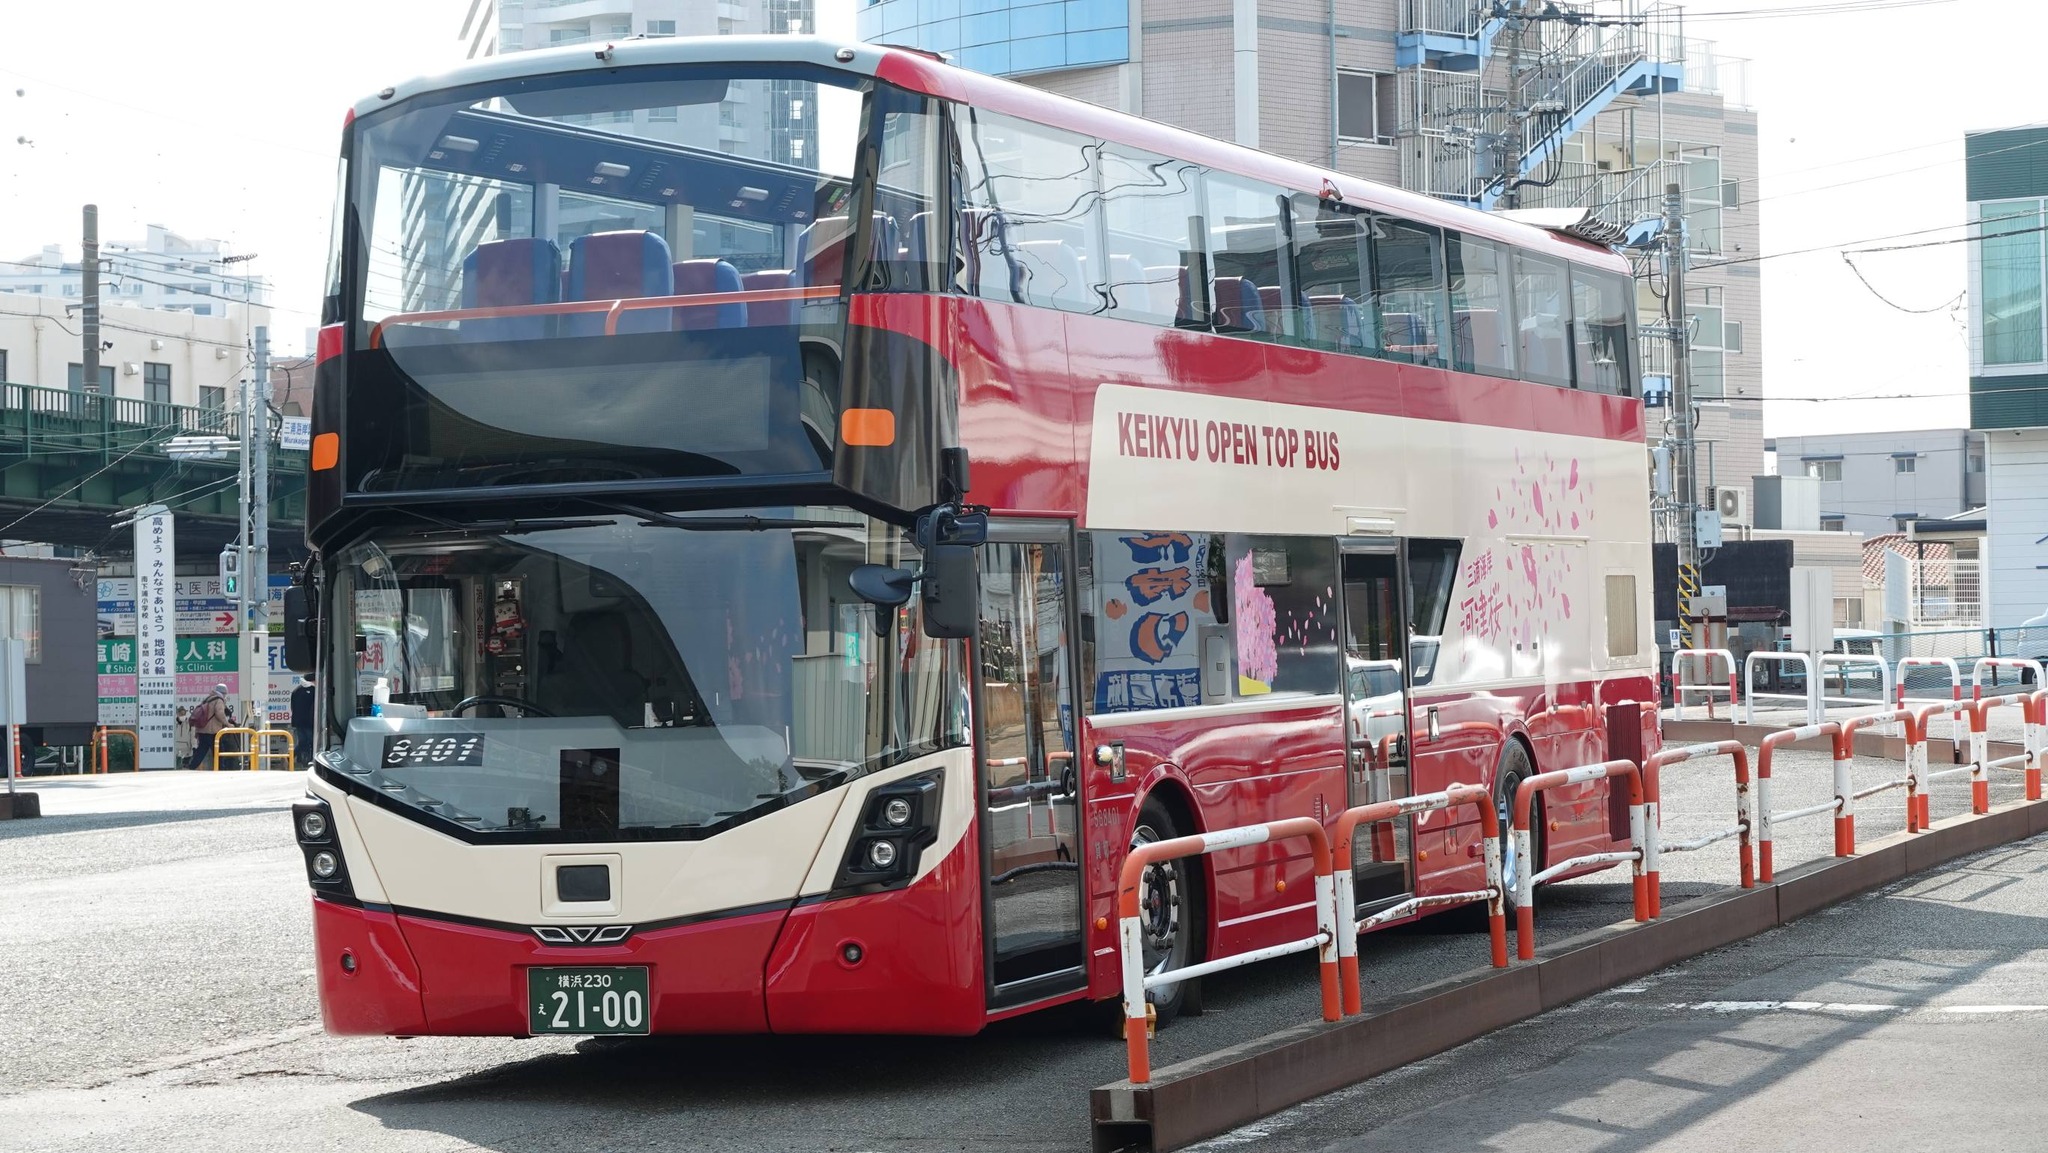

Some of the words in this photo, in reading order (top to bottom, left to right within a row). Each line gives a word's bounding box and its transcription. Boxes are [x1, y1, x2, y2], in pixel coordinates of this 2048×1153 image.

[284, 421, 311, 435] 三浦海岸
[1118, 412, 1199, 462] KEIKYU
[1206, 420, 1258, 466] OPEN
[1262, 426, 1299, 468] TOP
[1304, 429, 1340, 471] BUS
[152, 517, 163, 554] 高めよう
[153, 560, 165, 632] みんなであいさつ
[154, 639, 166, 675] 地域の輪
[187, 663, 213, 672] Clinic
[387, 738, 478, 763] 8401
[538, 1003, 547, 1015] え
[551, 990, 642, 1028] 21-00
